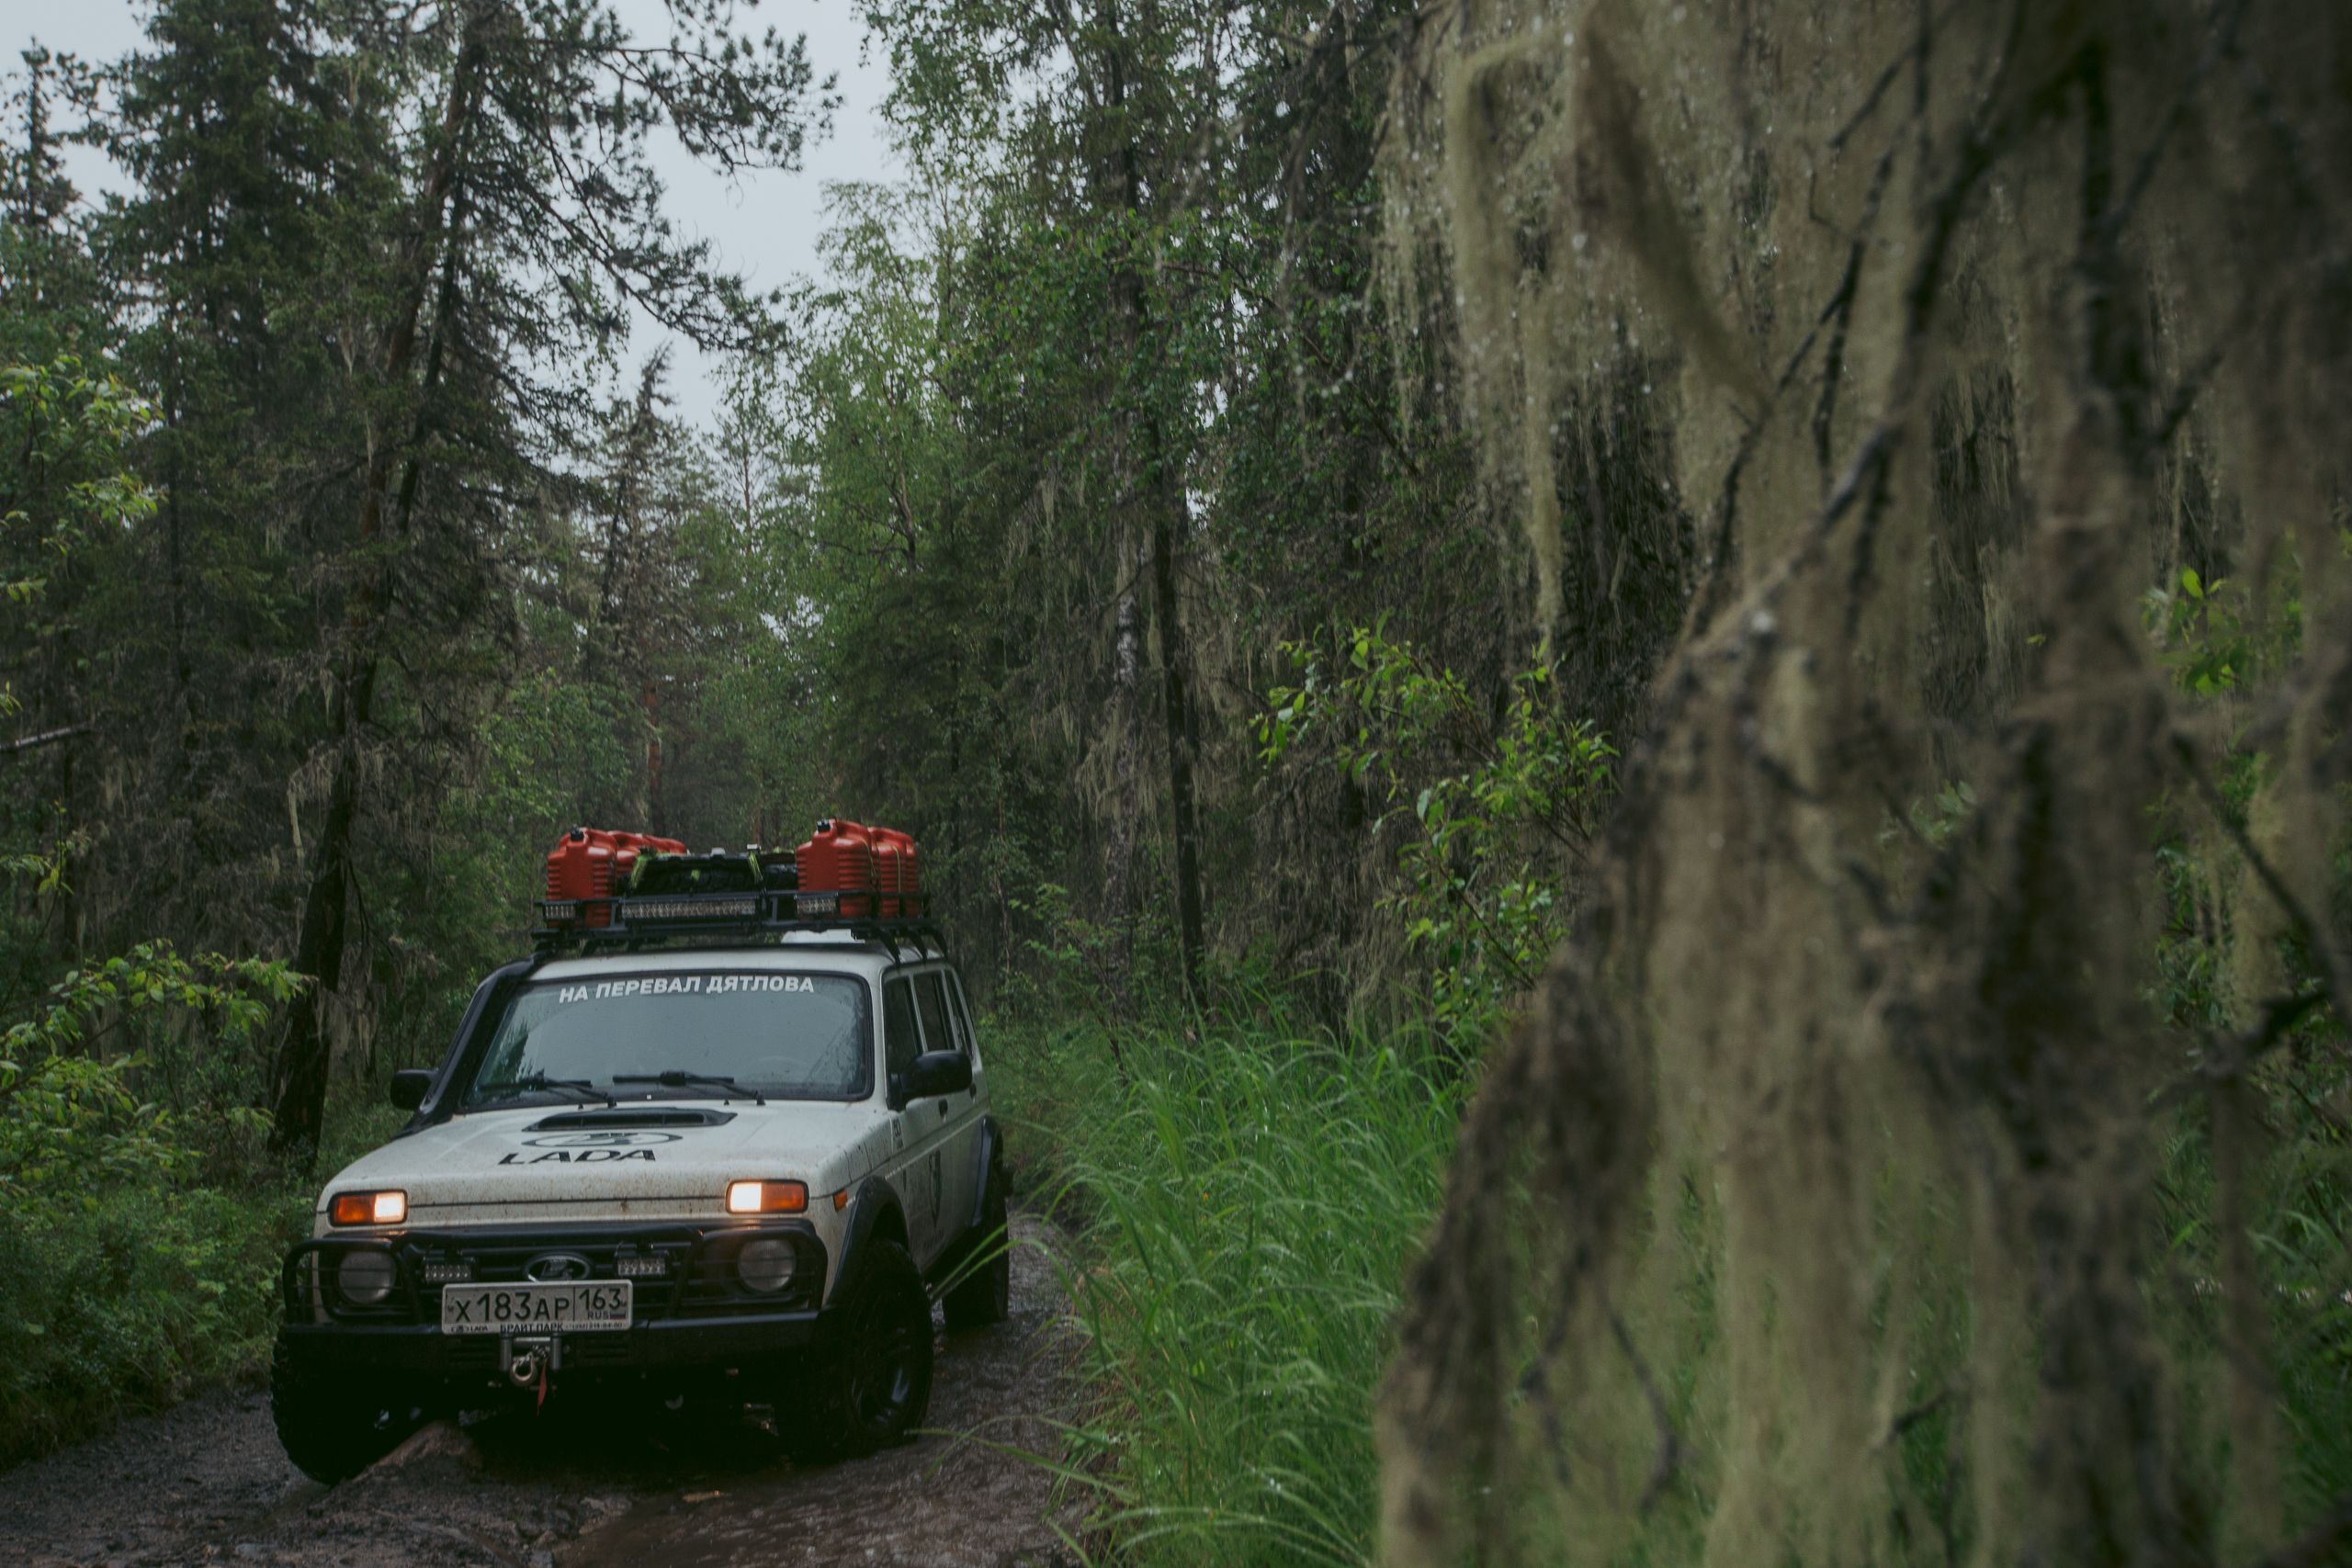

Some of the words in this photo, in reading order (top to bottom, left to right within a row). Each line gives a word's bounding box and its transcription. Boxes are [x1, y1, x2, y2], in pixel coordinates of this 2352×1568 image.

[559, 985, 589, 1003] НА
[595, 976, 701, 998] ПЕРЕВАЛ
[706, 976, 815, 994] ДЯТЛОВА
[498, 1149, 656, 1165] LADA
[579, 1288, 621, 1311] 163
[587, 1311, 610, 1320] RUS
[536, 1323, 564, 1332] ПАРК
